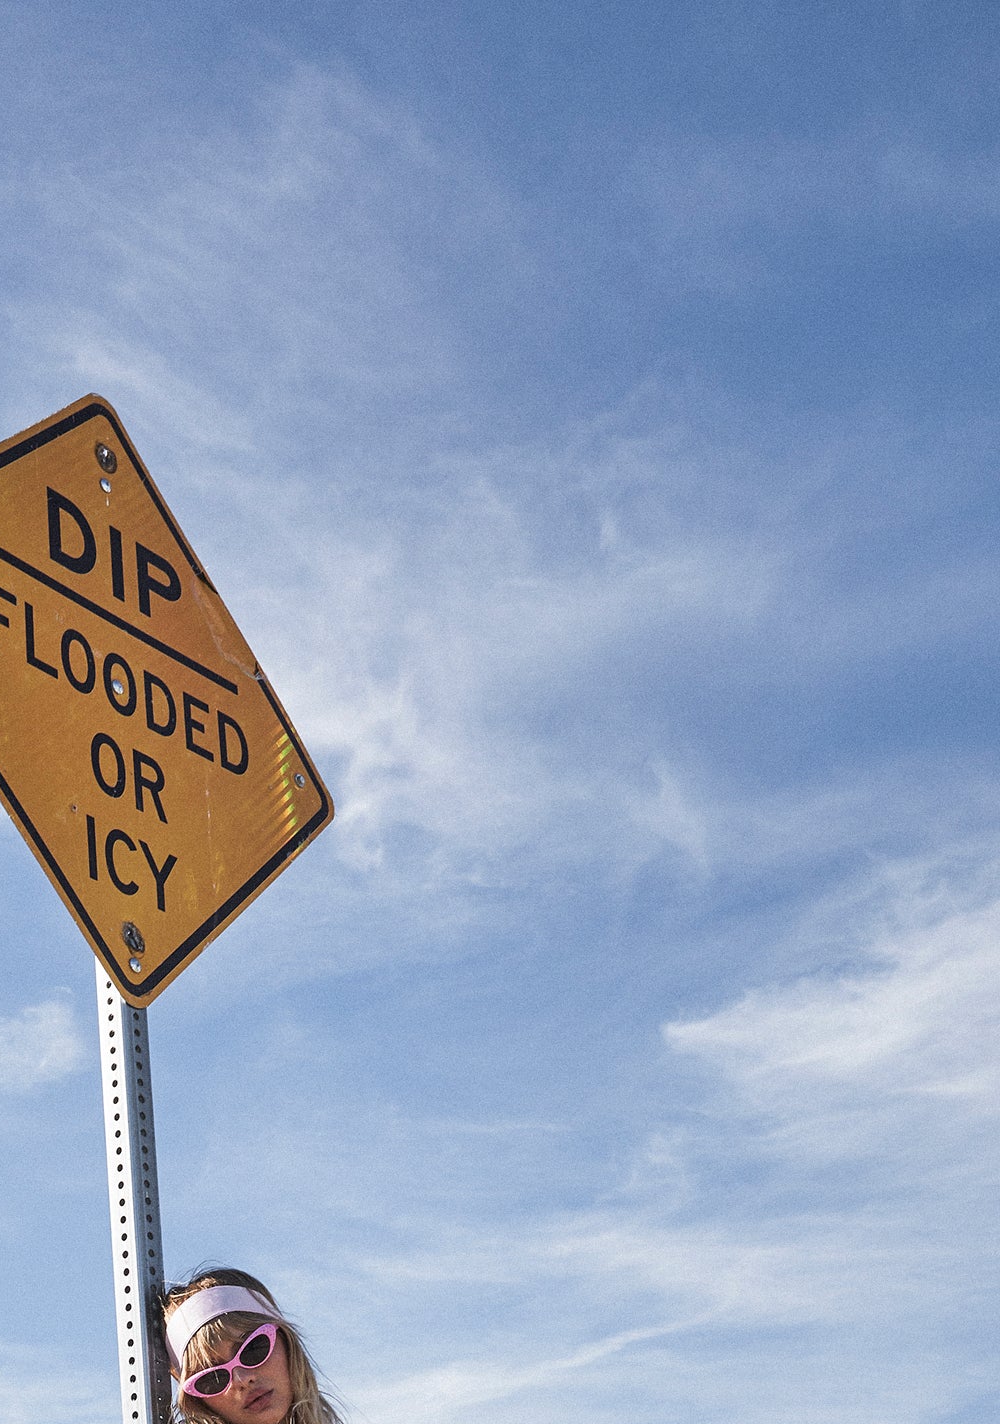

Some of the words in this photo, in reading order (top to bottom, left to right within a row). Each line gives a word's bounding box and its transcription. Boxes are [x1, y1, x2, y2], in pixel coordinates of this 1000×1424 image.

[46, 485, 182, 618] DIP
[90, 732, 169, 825] OR
[85, 813, 178, 913] ICY
